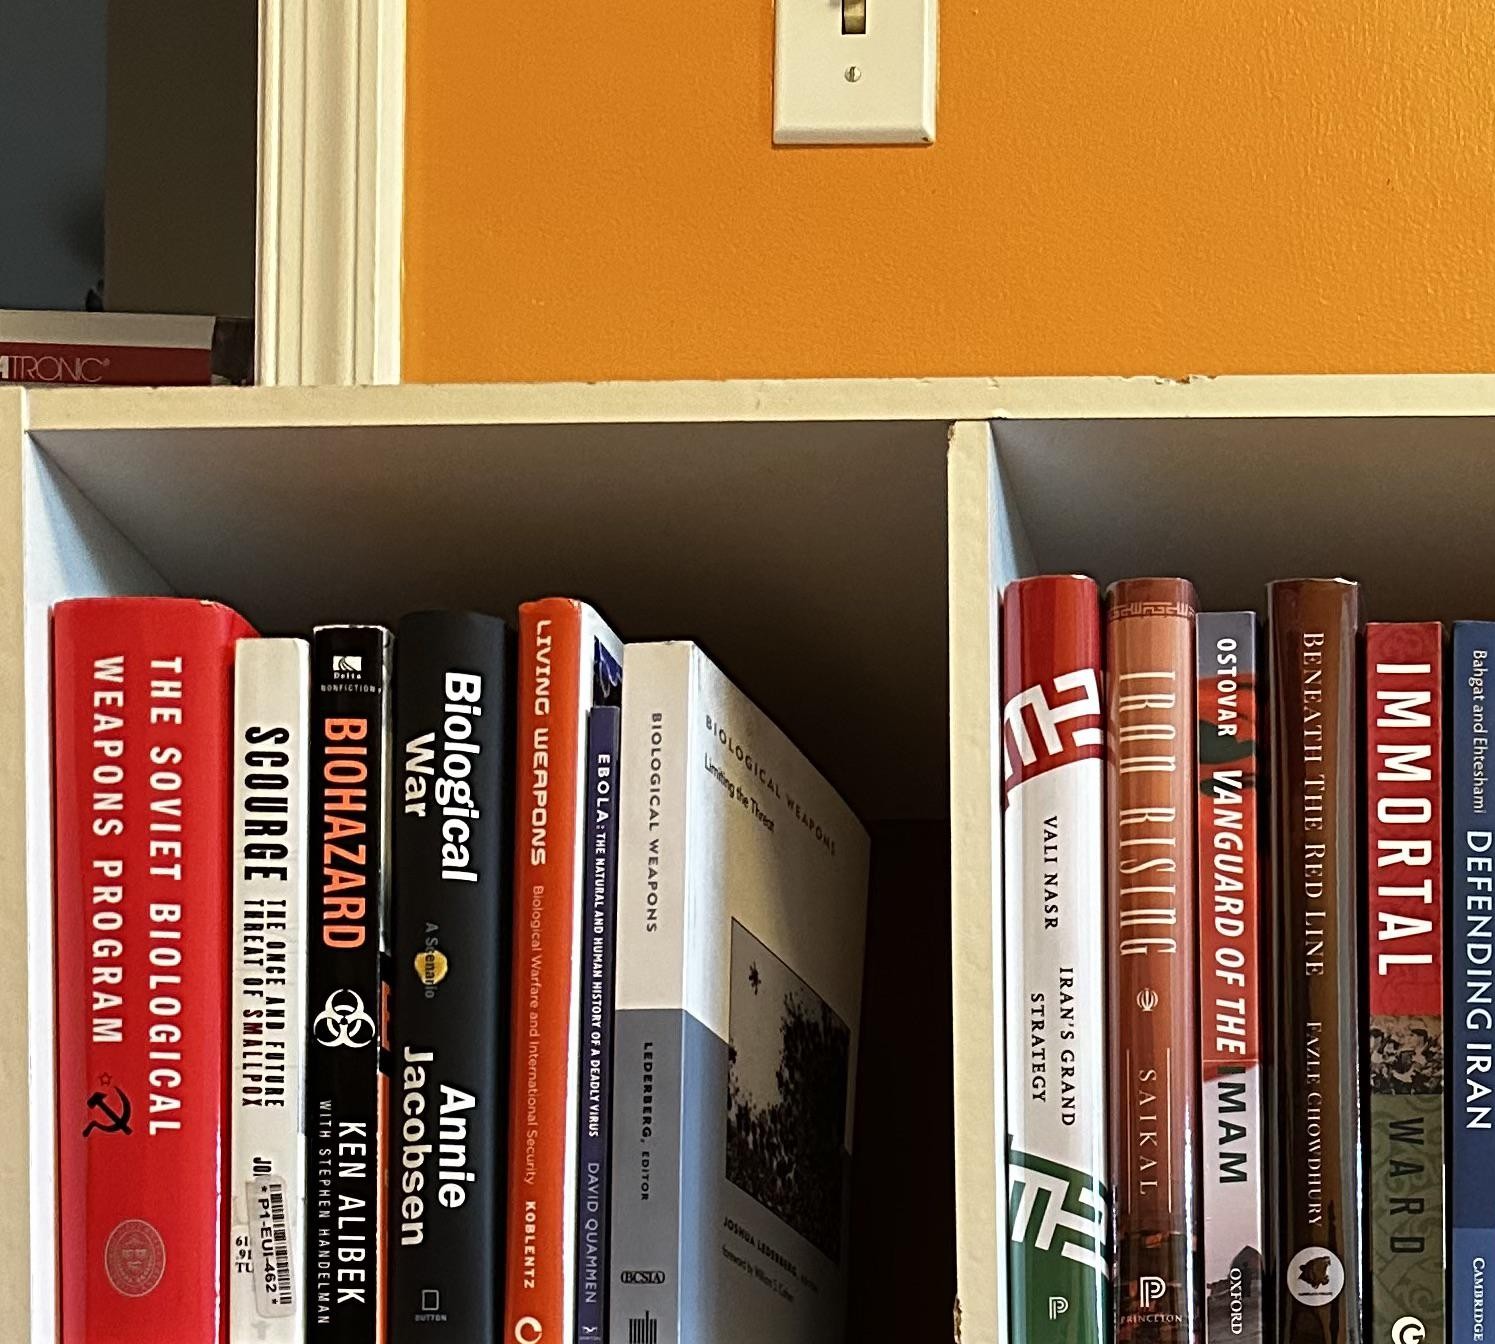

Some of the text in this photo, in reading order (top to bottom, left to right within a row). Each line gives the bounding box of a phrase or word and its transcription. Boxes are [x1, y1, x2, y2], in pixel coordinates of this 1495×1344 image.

[531, 620, 552, 865] LIVING WEAPONS
[1216, 638, 1237, 736] OSTOVAR
[93, 656, 124, 1044] WEAPONS PROGRAM
[243, 726, 289, 881] SCOURGE
[324, 718, 367, 949] BIOHAZARD
[404, 733, 435, 818] War
[437, 671, 481, 881] Biological
[1377, 663, 1432, 976] IMMORTAL
[149, 657, 181, 1136] THE SOVIET BIOLOGICAL
[1043, 816, 1059, 930] VALI NASR
[1028, 993, 1046, 1103] STRATEGY
[1058, 967, 1077, 1126] IRAN'S GRAND
[1214, 769, 1247, 1184] VANGUARD OF THE IMAM
[1465, 830, 1492, 1130] DEFENDING IRAN
[400, 1047, 434, 1246] Jacobsen
[438, 1084, 475, 1208] Annie
[258, 1198, 277, 1293] P1-EUI-462
[524, 1201, 536, 1289] KOBLENTZ
[584, 1163, 600, 1303] DAVID QUAMMEN
[1472, 1257, 1486, 1342] CAMBRIDGE
